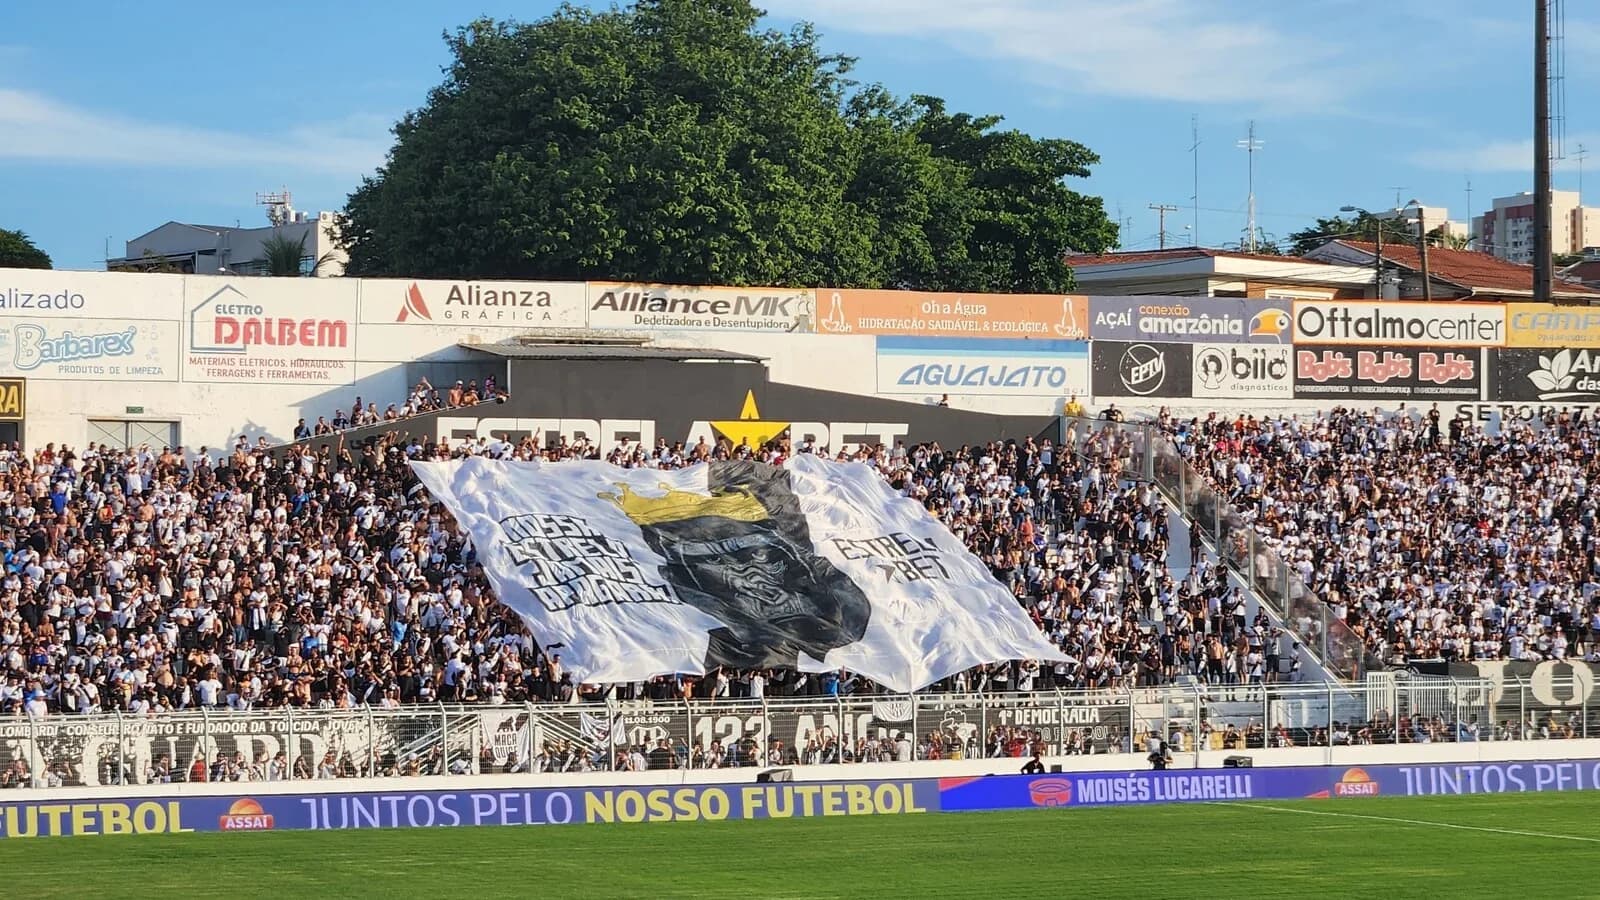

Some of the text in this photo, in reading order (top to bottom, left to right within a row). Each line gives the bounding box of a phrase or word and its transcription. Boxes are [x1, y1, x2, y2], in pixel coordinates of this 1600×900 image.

[445, 285, 552, 307] Alianza
[215, 304, 263, 315] ELETRO
[444, 309, 552, 321] GRÁFICA
[942, 304, 951, 315] a
[954, 298, 987, 317] Água
[1139, 304, 1190, 316] conexão
[634, 314, 702, 327] Dedetizadora
[713, 317, 790, 330] Desentupidora
[928, 318, 981, 332] SAUDÁVEL
[982, 322, 990, 332] &
[992, 319, 1048, 333] ECOLÓGICA
[1095, 308, 1132, 329] AÇAÍ
[1138, 313, 1243, 335] amazônia
[1298, 306, 1503, 341] Oftalmocenter
[214, 316, 348, 348] DALBEM
[58, 365, 164, 376] PRODUTOS DE LIMPEZA
[189, 357, 236, 367] MATERIAIS
[1297, 350, 1475, 384] Bob's Bob's Bob's
[206, 369, 256, 378] FERRAGENS
[259, 370, 264, 378] E
[897, 364, 1067, 388] AGUAJATO
[893, 555, 951, 582] BET
[250, 721, 267, 732] DA
[1014, 708, 1100, 726] DEMOCRACIA
[1077, 773, 1253, 803] MOISÉS LUCARELLI
[1399, 764, 1527, 796] JUNTOS
[301, 783, 927, 829] JUNTOS PELO NOSSO FUTEBOL
[0, 801, 194, 837] UTEBOL
